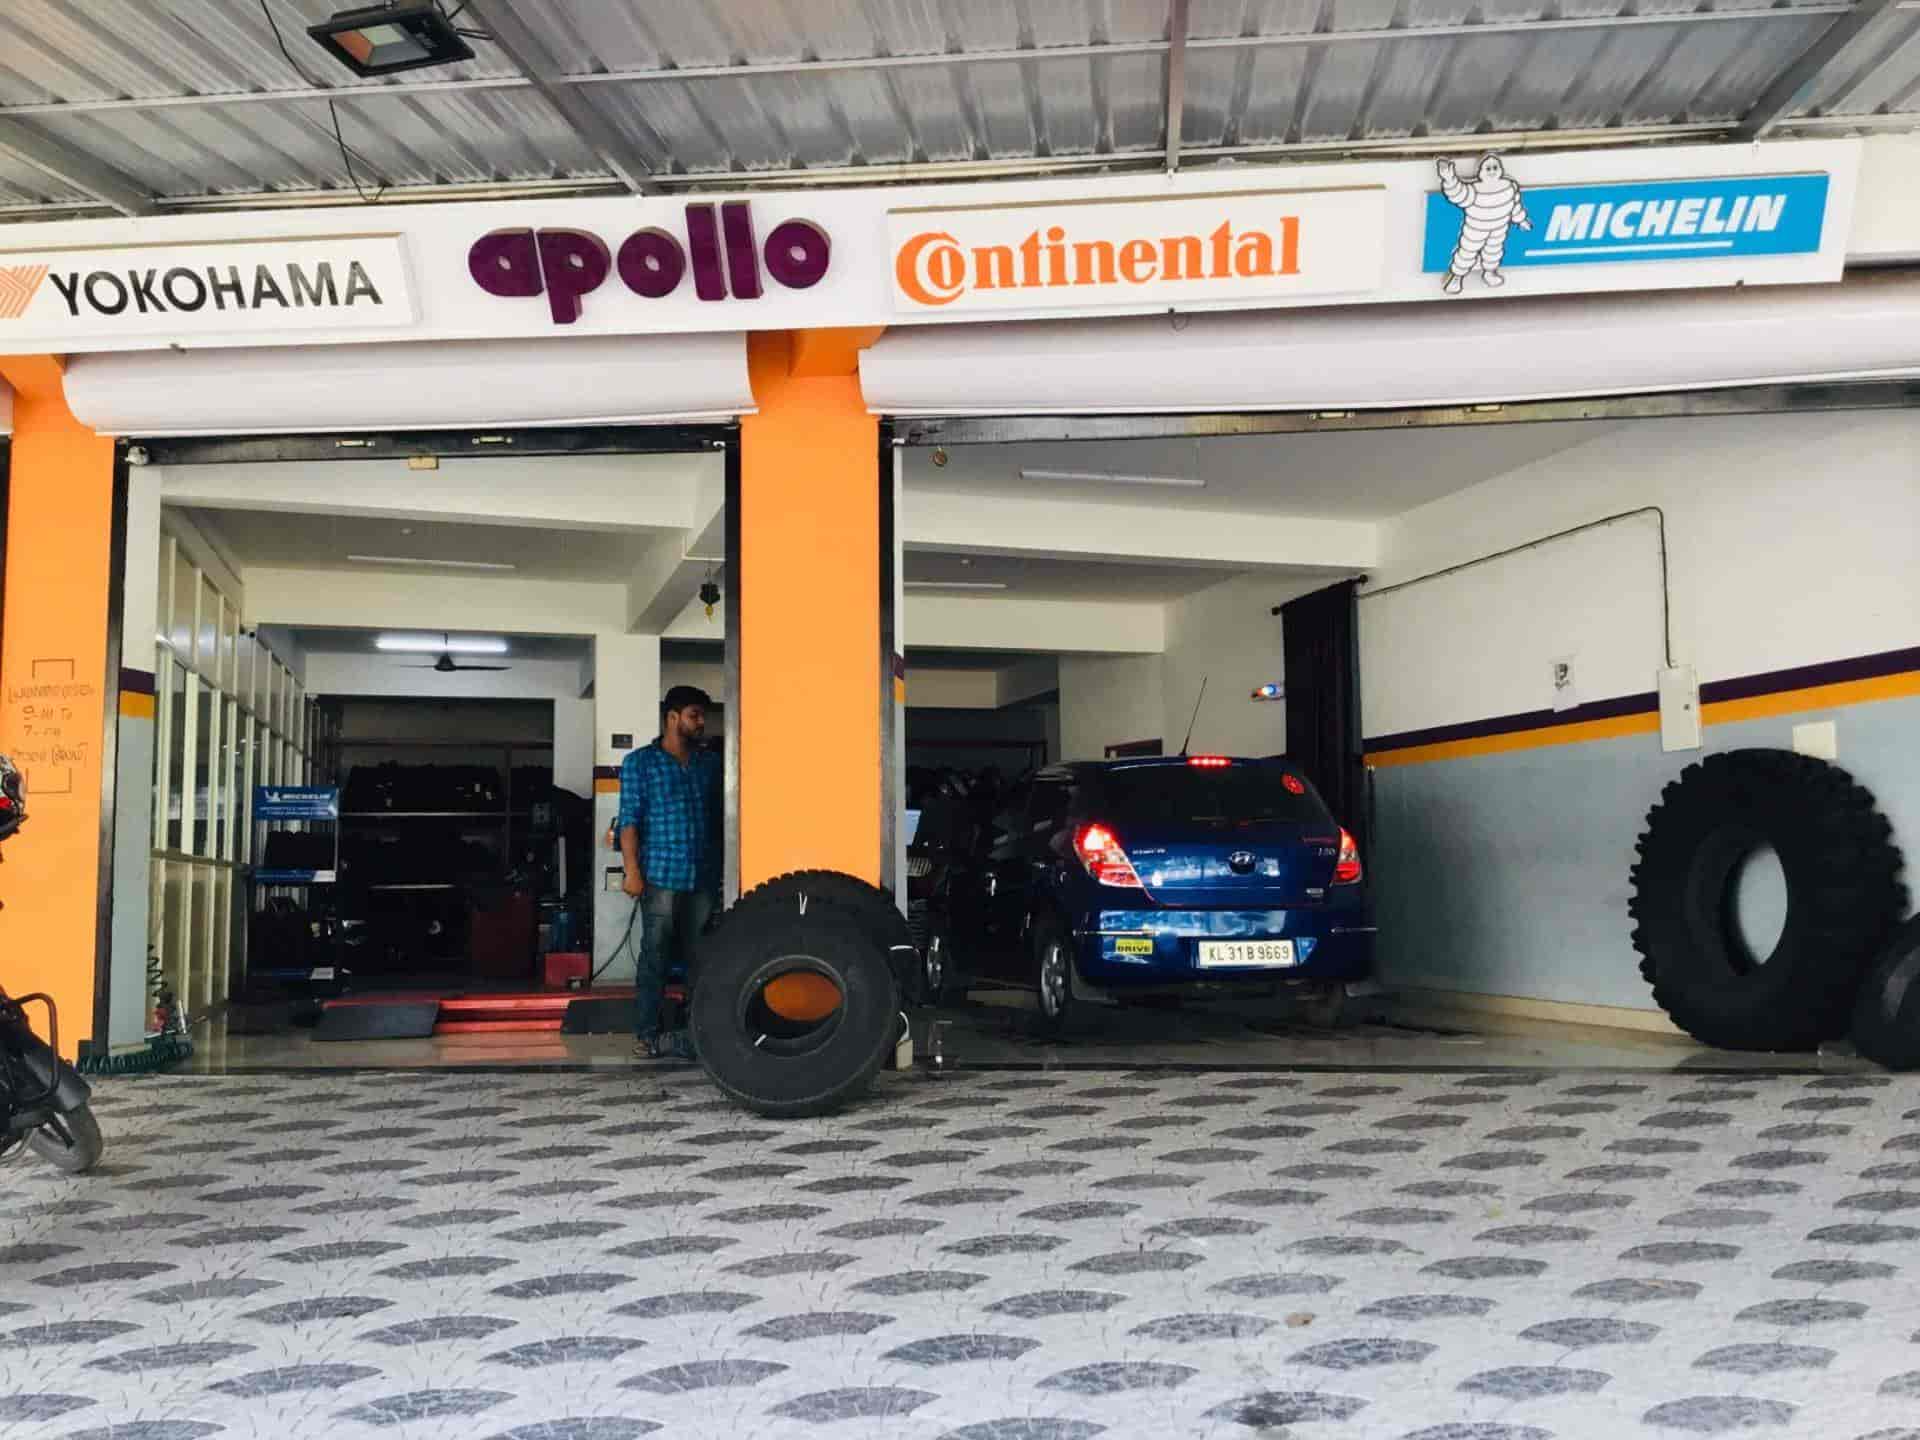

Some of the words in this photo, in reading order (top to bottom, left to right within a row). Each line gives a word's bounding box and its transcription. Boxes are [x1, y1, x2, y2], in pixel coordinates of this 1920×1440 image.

[1544, 192, 1786, 243] MICHELIN
[468, 201, 832, 325] apollo
[896, 217, 1299, 305] Continental
[50, 260, 383, 317] YOKOHAMA
[1117, 944, 1151, 953] DRIVE
[1208, 946, 1224, 961] KL
[1227, 946, 1242, 960] 31
[1247, 946, 1255, 960] B
[1257, 945, 1289, 960] 9669
